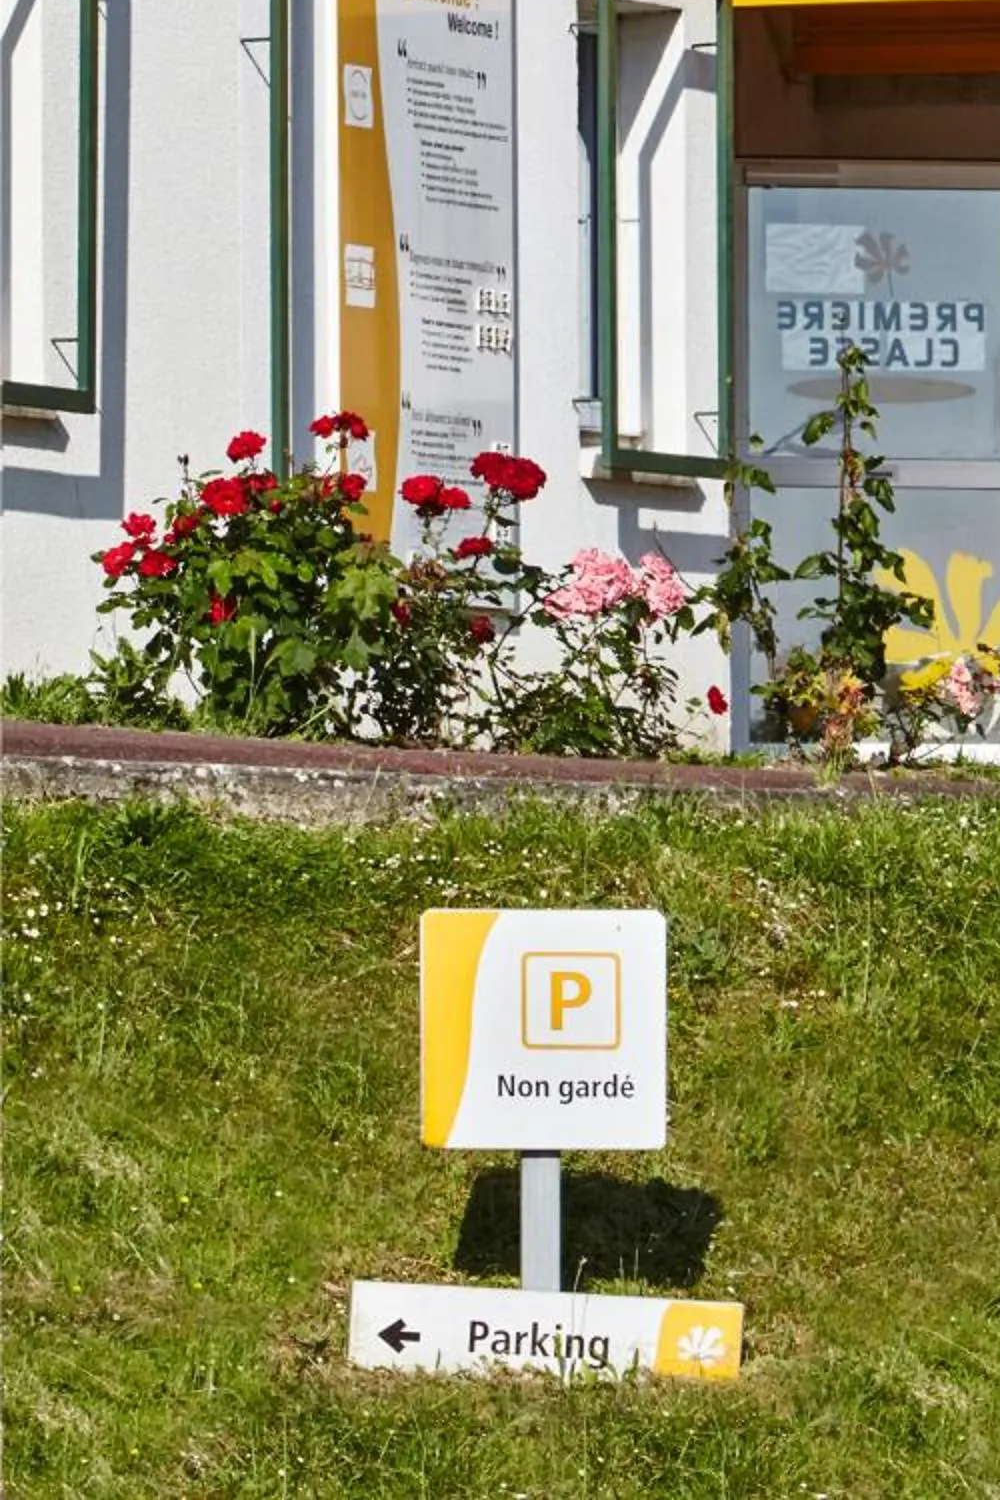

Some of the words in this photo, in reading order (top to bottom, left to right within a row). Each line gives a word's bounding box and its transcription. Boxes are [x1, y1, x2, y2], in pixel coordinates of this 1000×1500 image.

[447, 11, 493, 40] Welcome
[550, 971, 593, 1031] P
[497, 1074, 550, 1097] Non
[559, 1073, 635, 1105] gardé
[468, 1320, 609, 1370] Parking
